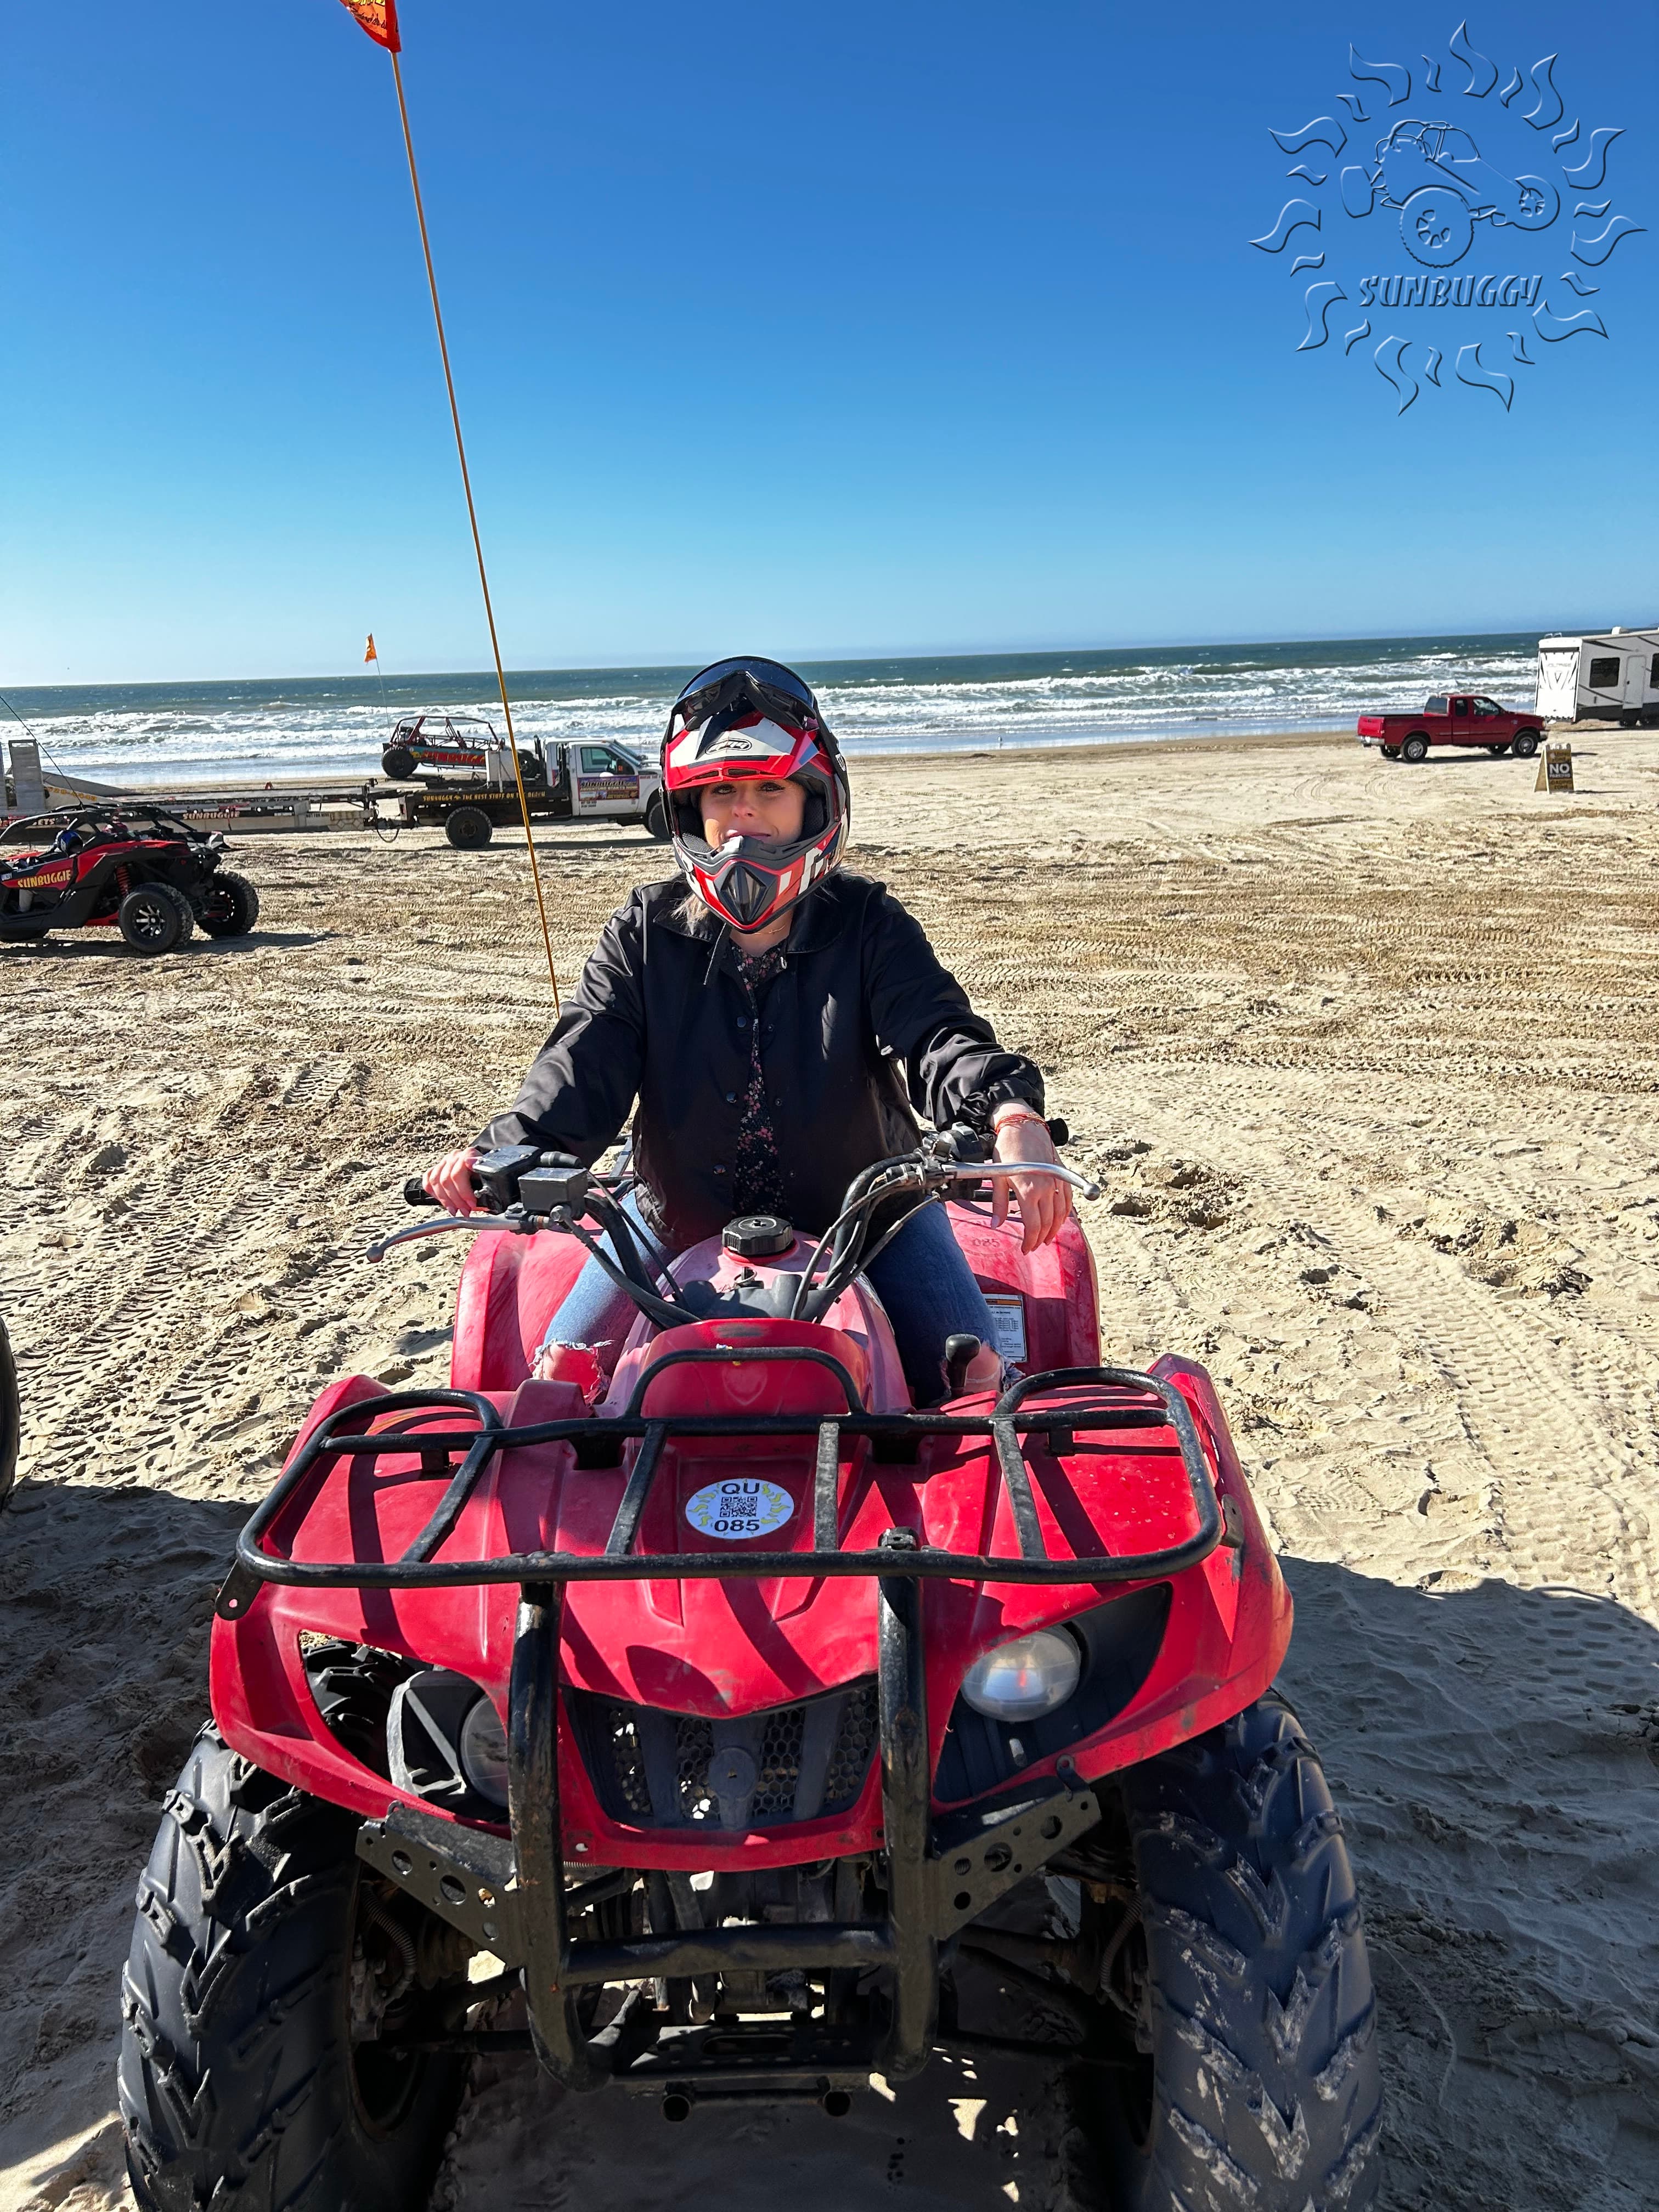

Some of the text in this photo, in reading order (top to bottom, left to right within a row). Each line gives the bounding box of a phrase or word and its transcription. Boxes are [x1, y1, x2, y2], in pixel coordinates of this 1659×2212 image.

[1549, 764, 1570, 774] NO
[18, 870, 71, 888] SUNBUGGIE
[721, 1482, 759, 1494] QU
[714, 1519, 759, 1532] 085
